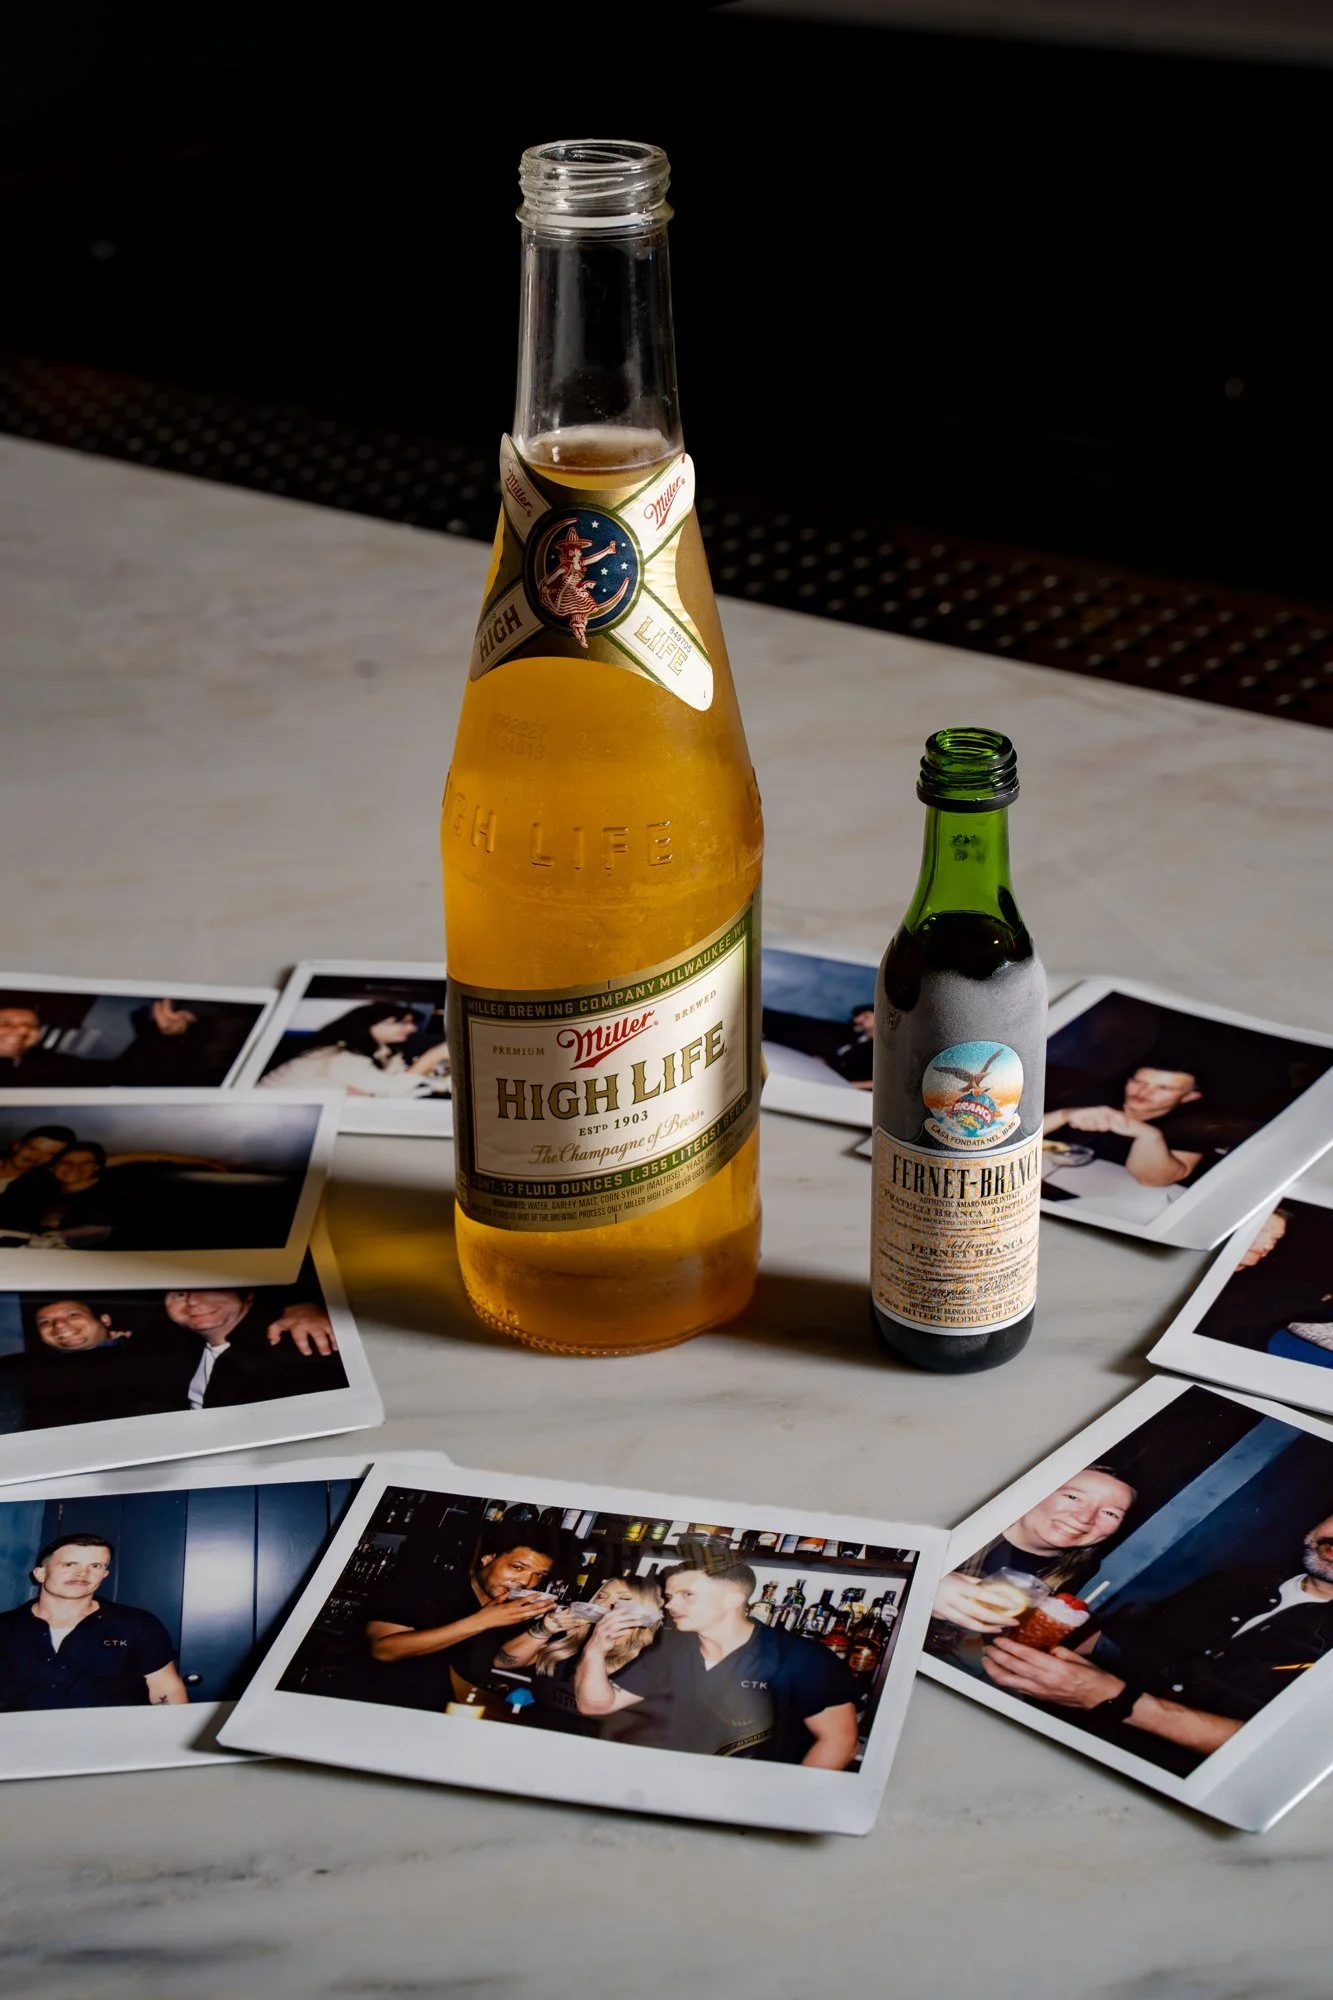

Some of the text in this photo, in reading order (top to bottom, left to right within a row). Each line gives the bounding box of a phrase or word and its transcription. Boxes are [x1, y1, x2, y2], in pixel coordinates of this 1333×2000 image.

[507, 461, 533, 511] Miller
[644, 475, 682, 531] Miller
[479, 604, 523, 664] HIGH
[634, 616, 688, 676] LIFE
[669, 626, 693, 653] 849705
[530, 820, 673, 870] LIFE
[468, 1000, 505, 1016] MILLER
[509, 1002, 573, 1017] BREWING
[580, 983, 655, 1012] COMPANY
[659, 936, 731, 991] MILWAUKEE
[674, 989, 717, 1022] BREWED
[492, 1045, 545, 1056] PREMIUM
[556, 1009, 655, 1070] Miller
[496, 1020, 726, 1120] HIGH LIFE
[614, 1110, 649, 1129] 1903
[953, 1101, 992, 1123] BRANCA
[527, 1143, 558, 1165] The
[558, 1137, 645, 1166] Champagne
[647, 1122, 663, 1151] of
[931, 1124, 949, 1140] CASA
[950, 1136, 985, 1146] FONDATA
[986, 1134, 1001, 1144] NEL
[501, 1182, 514, 1194] 12
[517, 1183, 555, 1196] FLUID
[561, 1174, 623, 1195] OUNCES
[630, 1157, 668, 1183] (.355
[672, 1125, 721, 1166] LITERS)
[551, 1200, 577, 1210] BARLEY
[600, 1191, 620, 1205] CORN
[620, 1184, 645, 1199] SYRUP
[578, 1207, 606, 1219] PROCESS
[623, 1196, 647, 1211] MILLER
[646, 1190, 662, 1203] HIGH
[662, 1185, 674, 1199] LIFE
[674, 1177, 693, 1192] NEVER
[919, 1196, 956, 1208] AUTHENTIC
[956, 1200, 980, 1208] AMARO
[981, 1197, 998, 1206] MADE
[934, 1208, 983, 1219] BRANCA
[911, 1243, 970, 1258] FERNET
[975, 1238, 1023, 1258] BRANCA
[947, 1239, 965, 1249] del
[903, 1299, 1024, 1323] BITTERS PRODUCT OF ITALY
[103, 1639, 128, 1647] CTK
[740, 1679, 769, 1690] CTK
